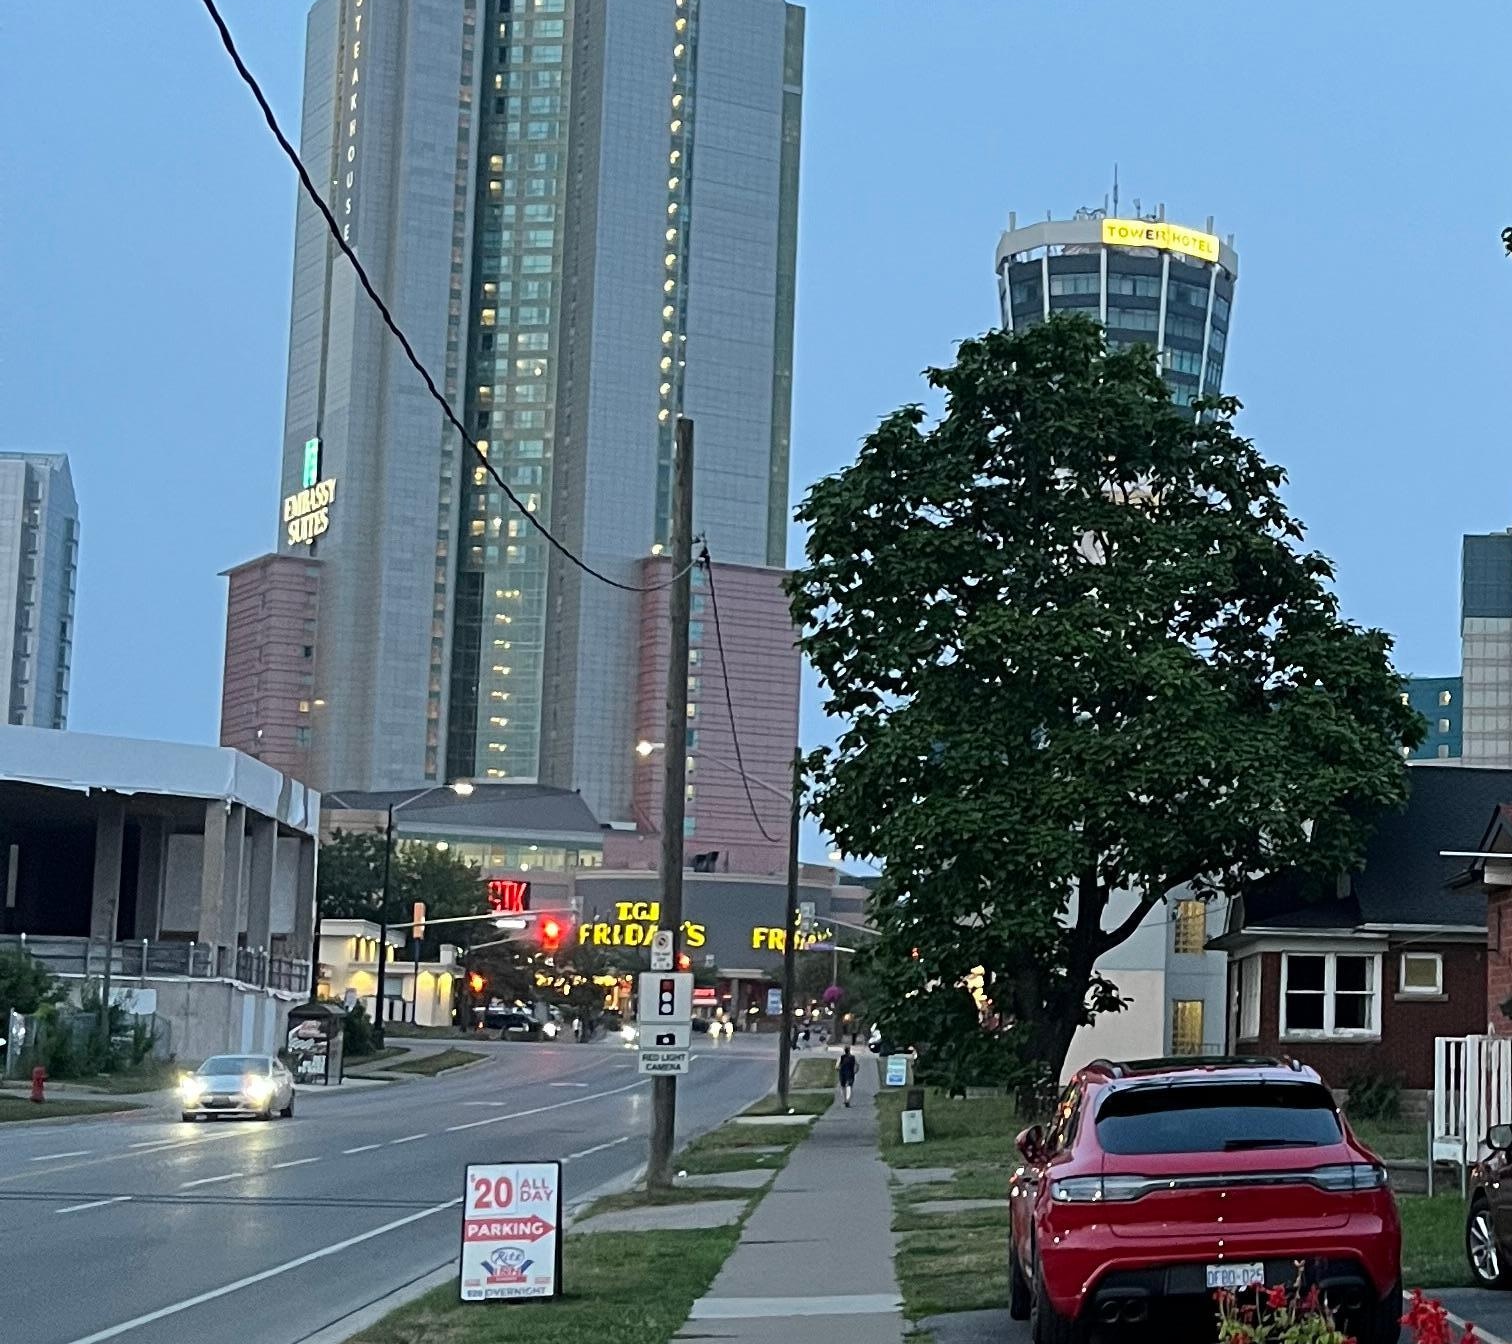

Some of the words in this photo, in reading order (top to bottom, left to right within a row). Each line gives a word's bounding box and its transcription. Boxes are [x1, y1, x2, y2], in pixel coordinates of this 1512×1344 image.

[1107, 225, 1166, 242] TOWER
[1171, 232, 1213, 254] HOTEL
[284, 478, 337, 523] EMBASSY
[287, 506, 329, 545] SUITES
[642, 1053, 659, 1062] RED
[661, 1053, 685, 1062] LIGHT
[645, 1063, 681, 1071] CAMERA
[520, 1178, 550, 1190] ALL
[520, 1190, 553, 1202] DAY
[467, 1221, 544, 1237] PARKING
